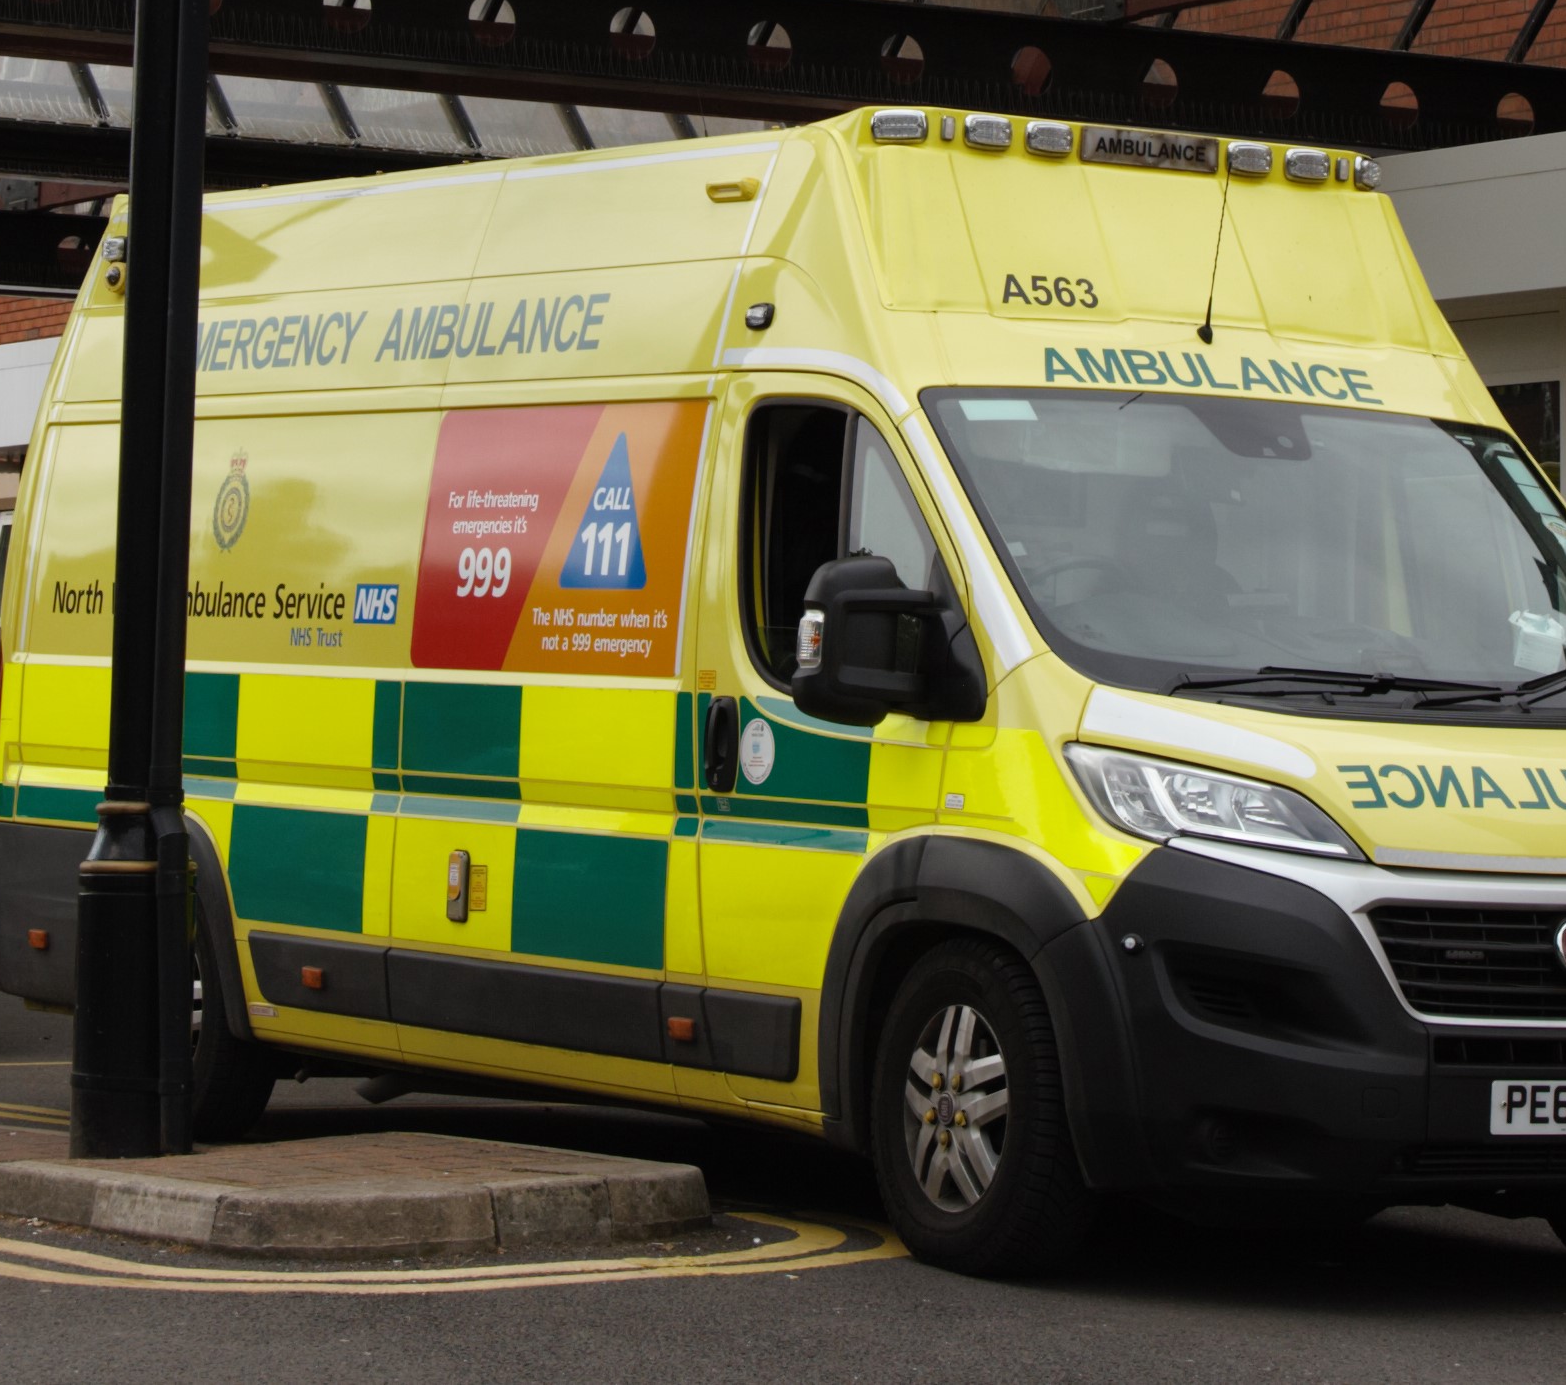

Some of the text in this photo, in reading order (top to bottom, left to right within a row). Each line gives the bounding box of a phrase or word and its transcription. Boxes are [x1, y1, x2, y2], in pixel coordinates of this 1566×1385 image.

[1095, 136, 1206, 163] AMBULANCE
[1002, 273, 1099, 310] A563
[196, 293, 611, 372] MERGENCY AMBULANCE
[1044, 347, 1385, 406] AMBULANCE
[448, 489, 540, 512] For life-threatening
[593, 486, 631, 511] CALL
[452, 515, 528, 538] emergencies it's
[580, 521, 632, 577] 111
[456, 546, 512, 598] 999
[52, 579, 103, 615] North
[273, 582, 345, 621] Service
[355, 588, 397, 620] NHS
[532, 607, 669, 629] The NHS number when it's
[290, 627, 343, 648] NHS Trust
[541, 634, 652, 659] not a 999 emergency
